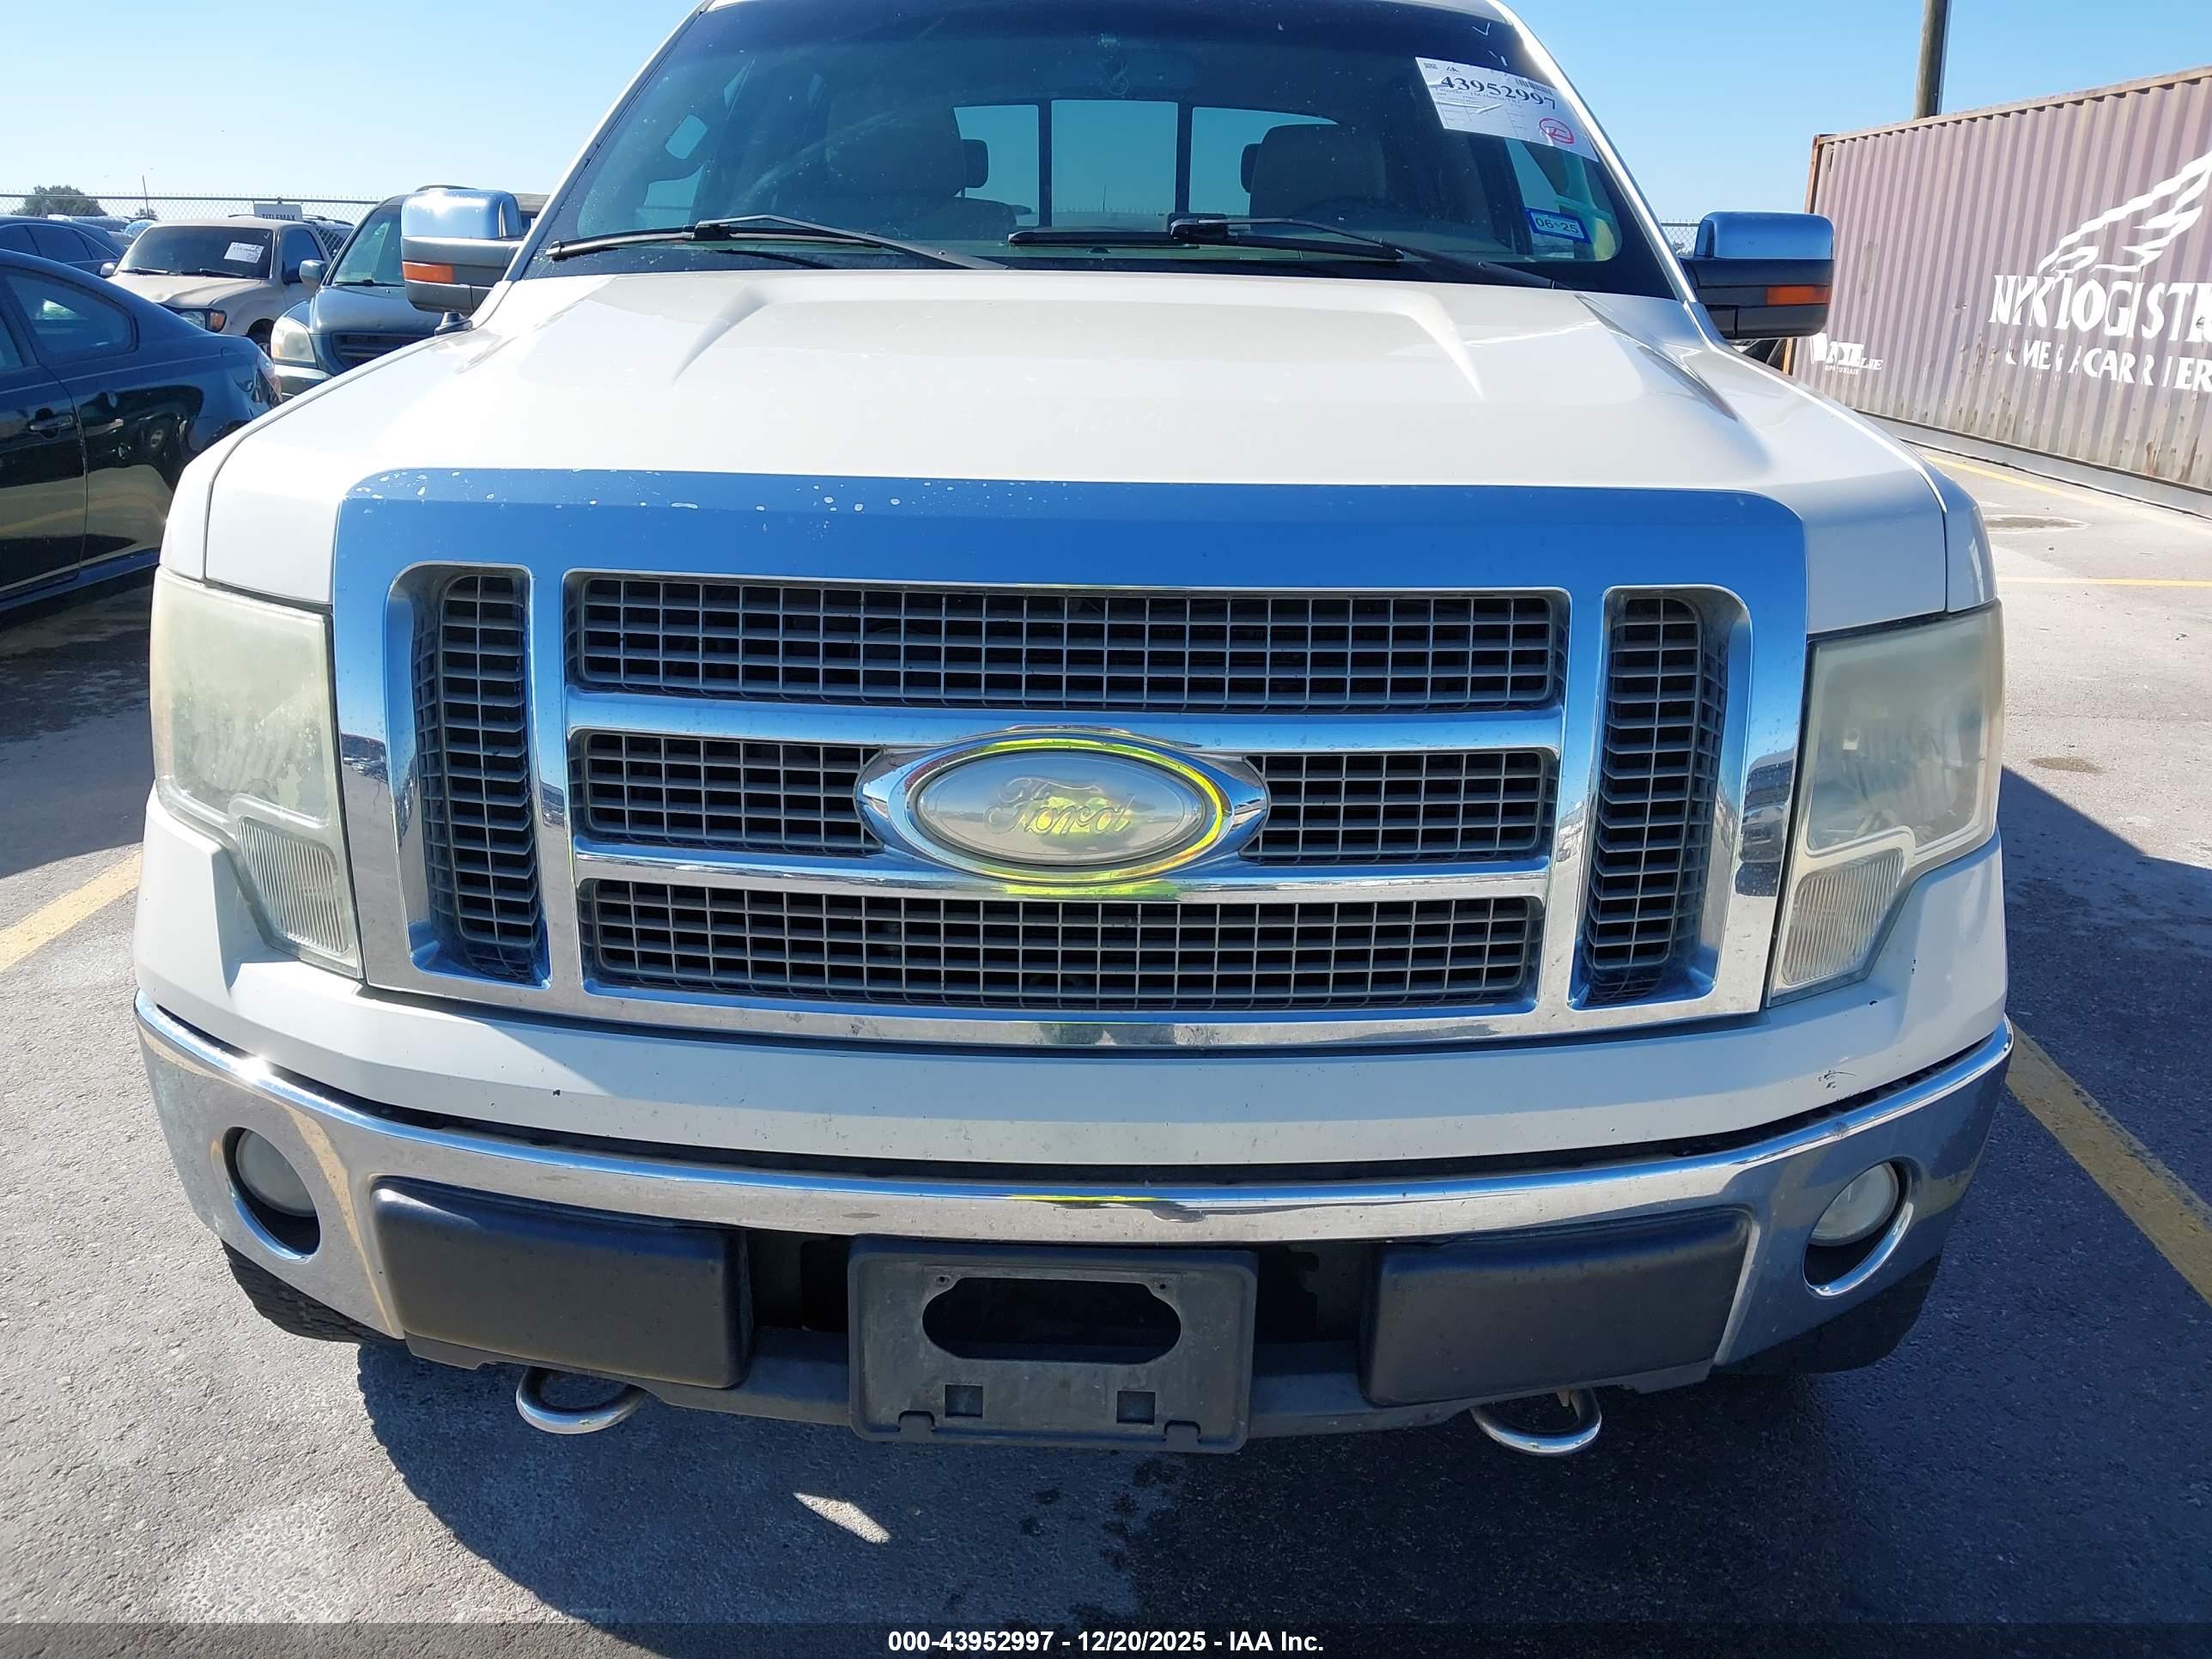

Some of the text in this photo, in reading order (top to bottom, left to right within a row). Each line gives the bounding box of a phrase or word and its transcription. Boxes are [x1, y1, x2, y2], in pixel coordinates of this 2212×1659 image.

[1441, 76, 1556, 110] 43952997
[1988, 274, 2057, 328] NYK
[982, 775, 1137, 838] Ford
